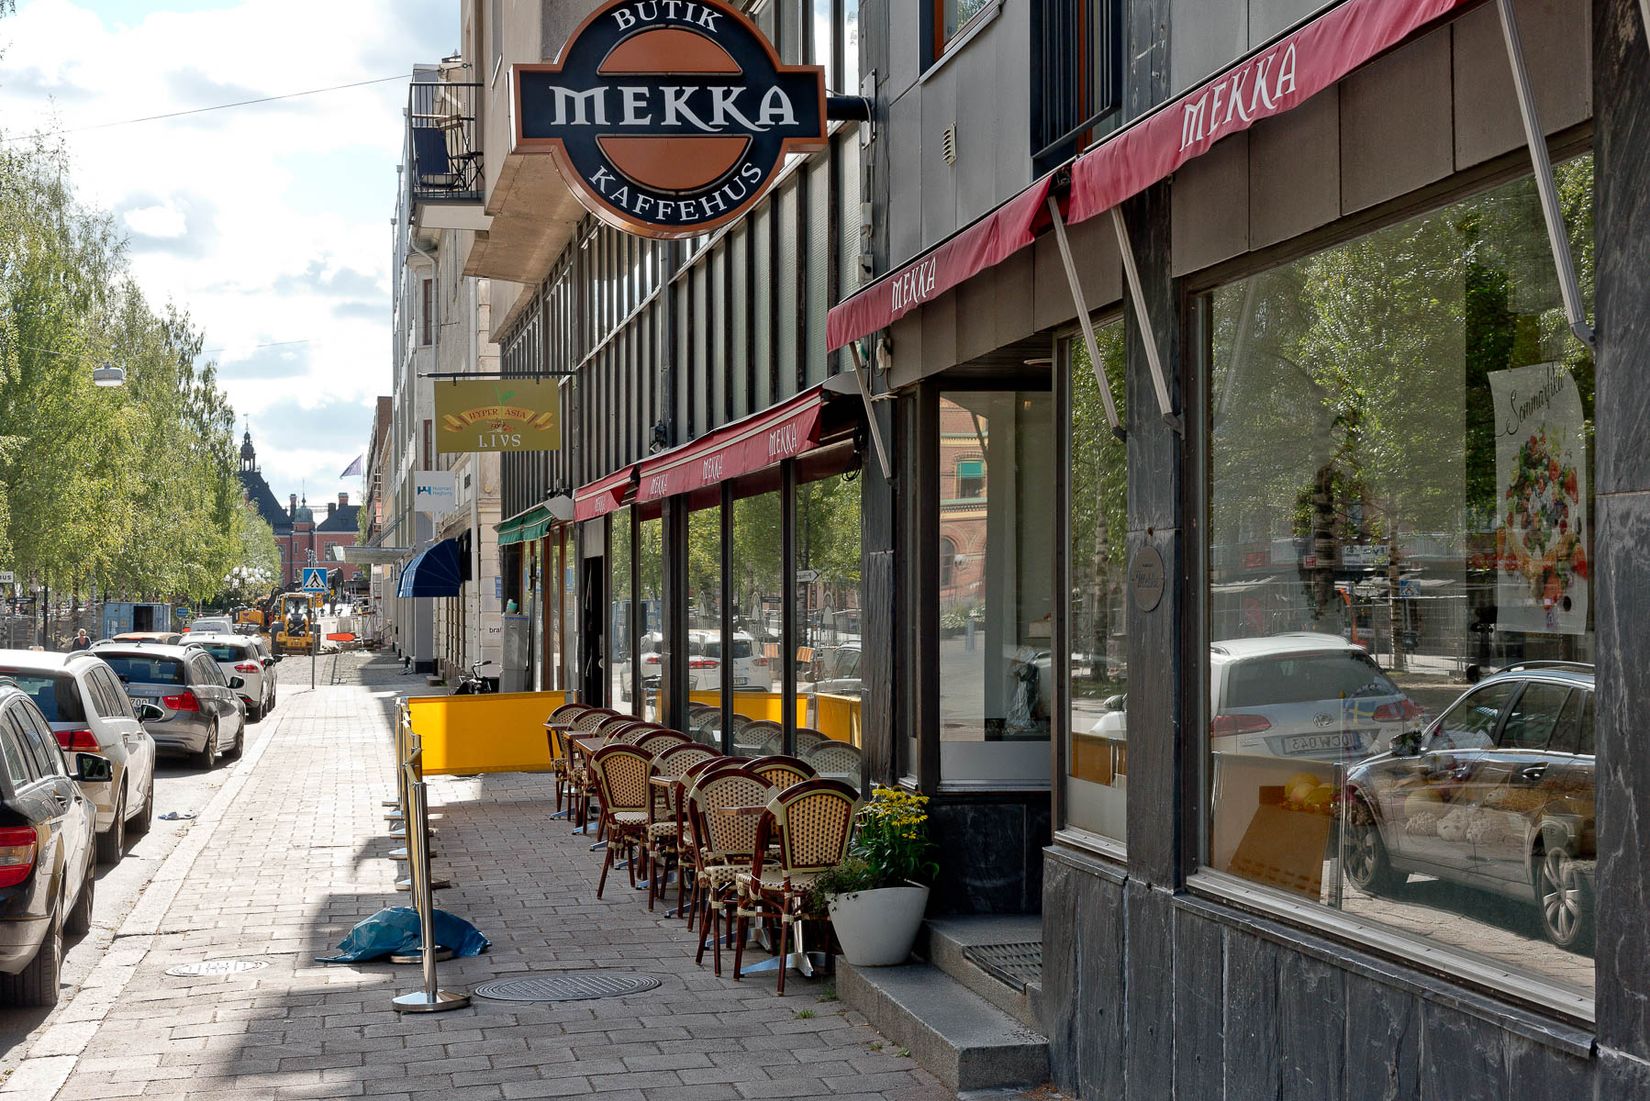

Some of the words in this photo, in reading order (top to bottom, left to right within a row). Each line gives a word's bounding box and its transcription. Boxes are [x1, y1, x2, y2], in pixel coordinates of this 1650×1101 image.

[610, 0, 724, 33] BUTIK
[548, 84, 800, 132] MEKKA
[1178, 41, 1298, 154] MEKKA
[588, 161, 763, 222] KAFFEHUS
[891, 256, 937, 313] MEKKA
[469, 408, 498, 420] HYPER
[505, 409, 526, 419] ASIA
[479, 434, 521, 448] LIVS
[769, 422, 798, 457] MEKKA
[702, 453, 724, 480] MEKKA
